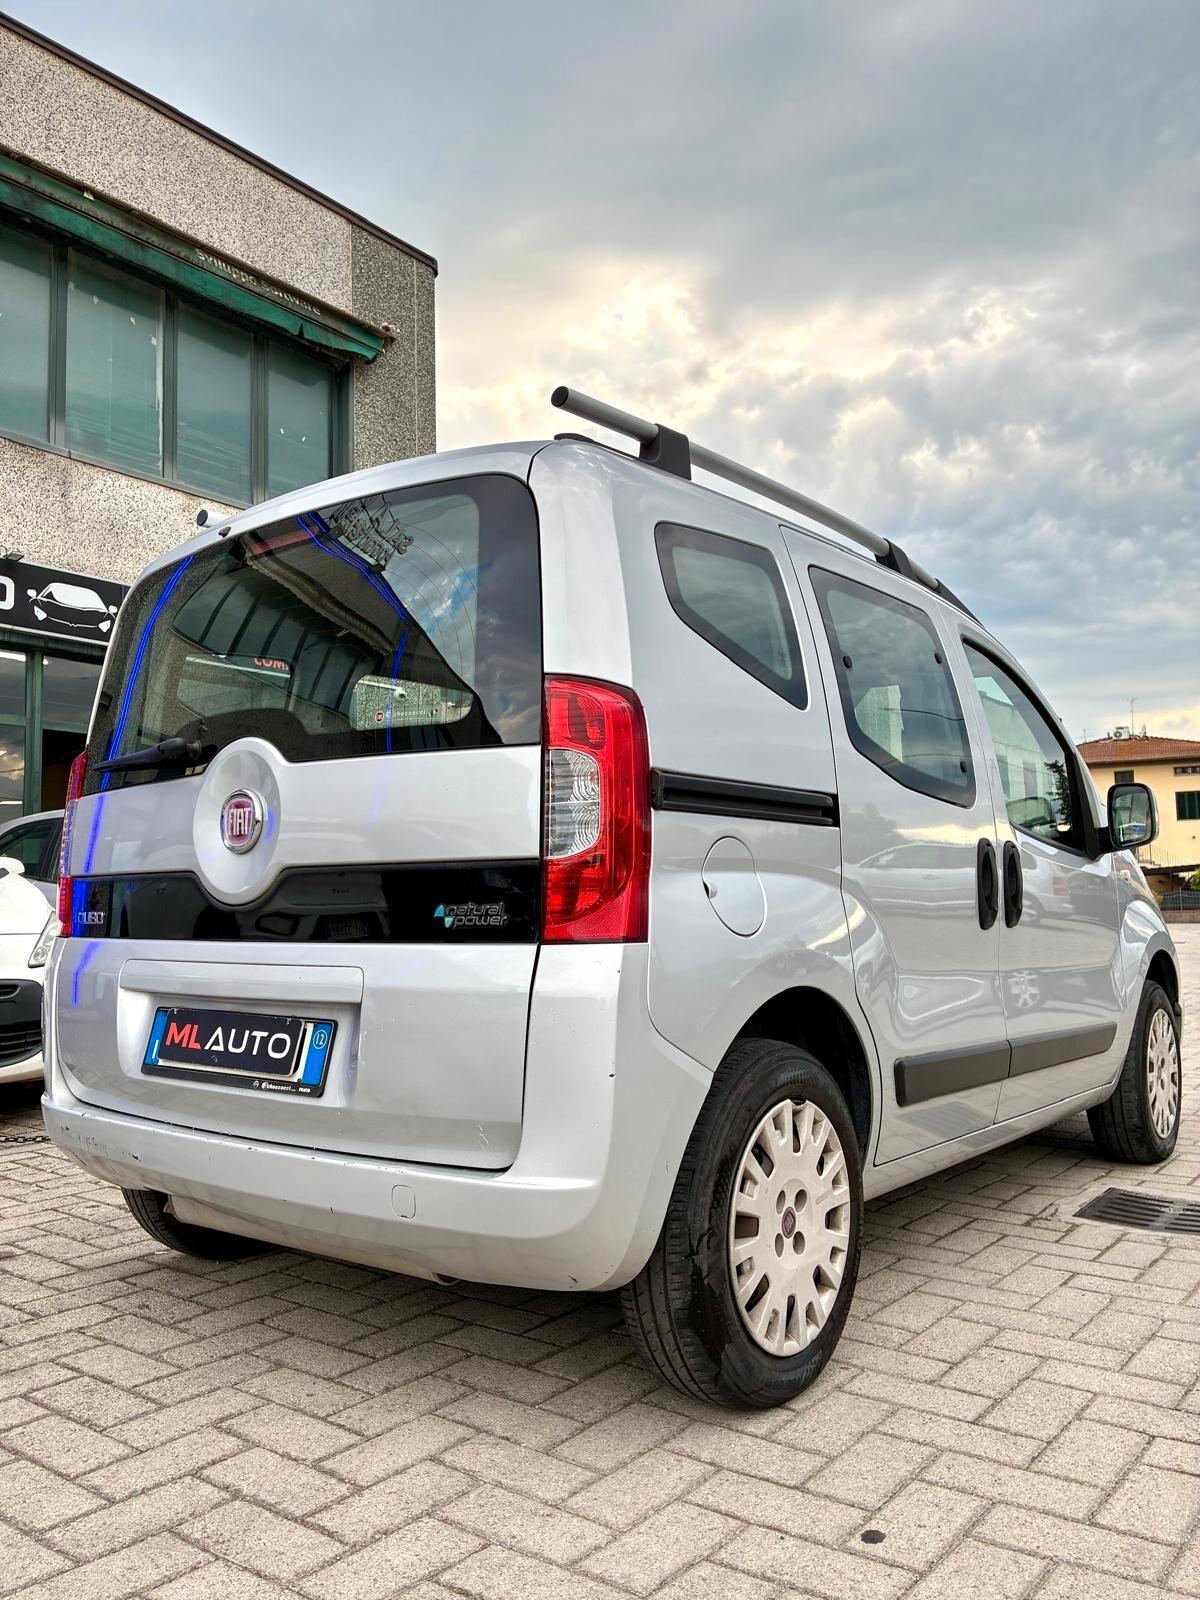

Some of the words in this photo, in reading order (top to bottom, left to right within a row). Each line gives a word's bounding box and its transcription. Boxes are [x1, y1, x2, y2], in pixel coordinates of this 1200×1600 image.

[228, 806, 251, 836] FIAT
[446, 901, 504, 915] natural
[453, 914, 508, 928] power
[165, 1022, 201, 1050] ML
[204, 1026, 291, 1059] AUTO
